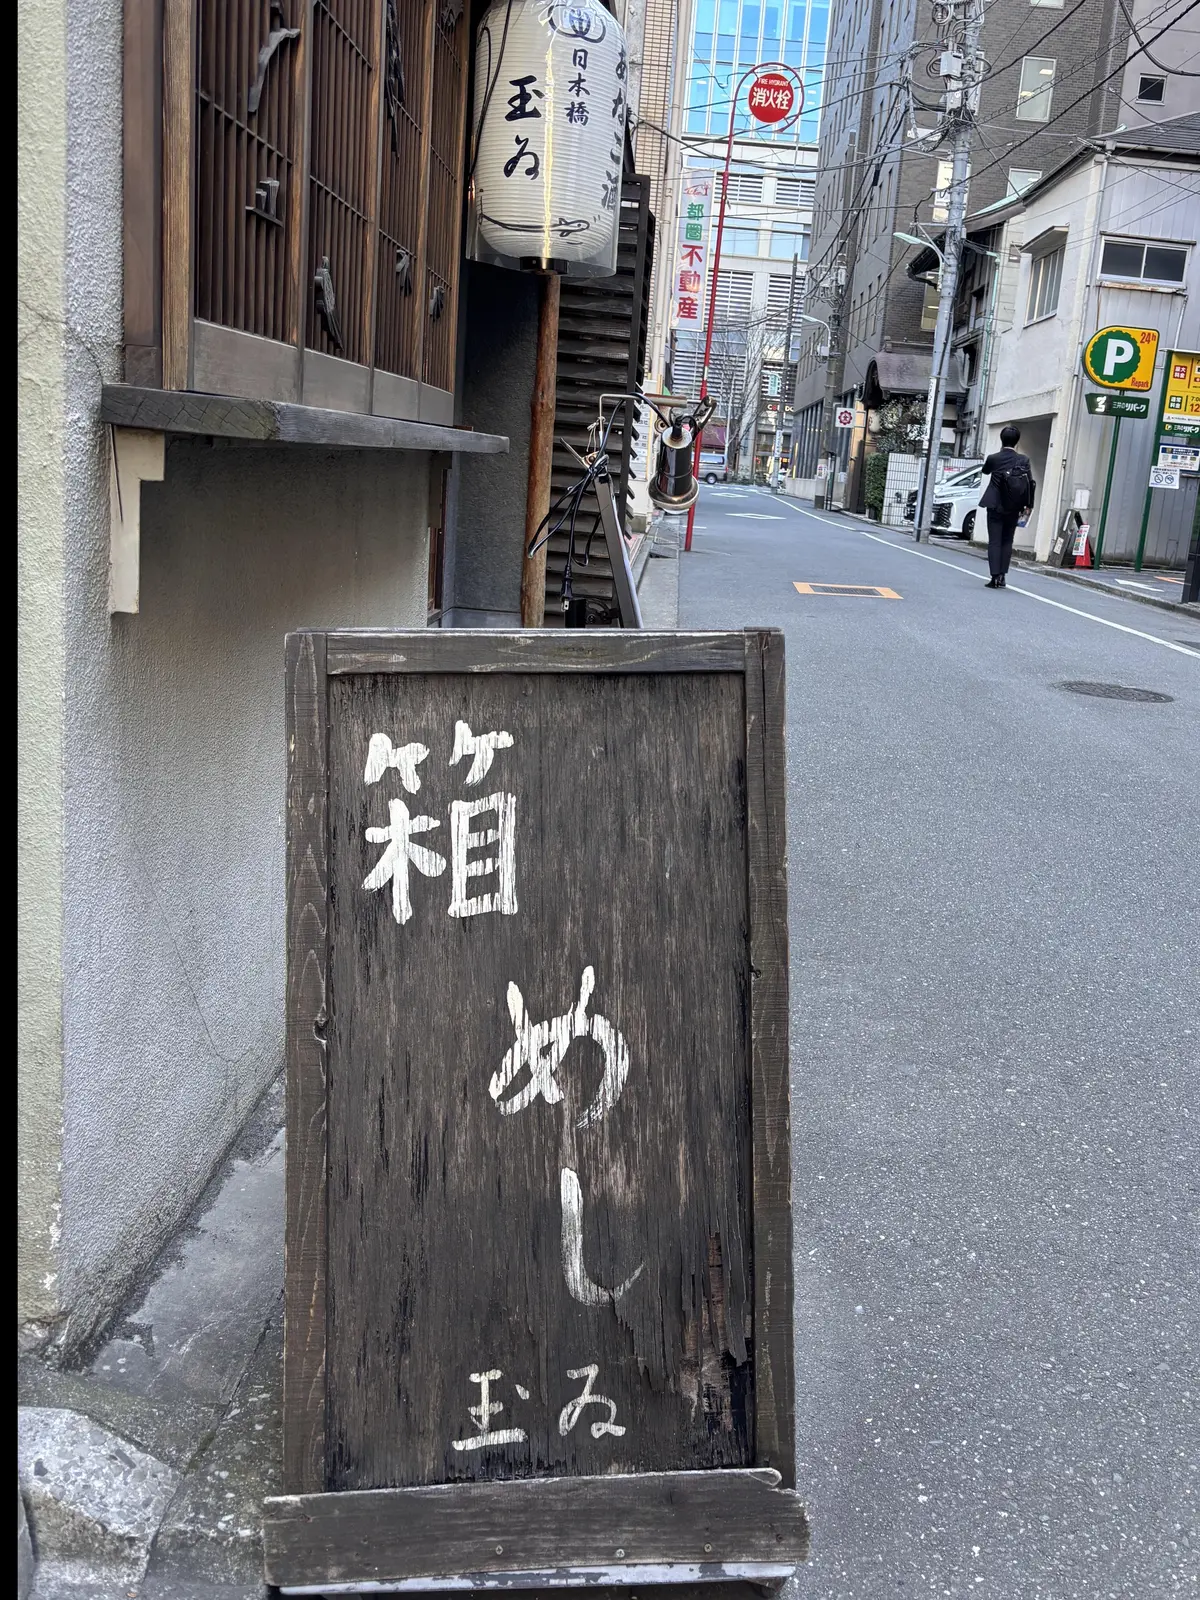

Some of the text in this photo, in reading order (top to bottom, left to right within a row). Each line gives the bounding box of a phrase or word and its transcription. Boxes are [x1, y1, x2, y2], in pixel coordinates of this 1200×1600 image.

[564, 49, 591, 126] 日本橋
[751, 87, 791, 110] 消火栓
[768, 79, 789, 87] HYDRANT
[676, 202, 704, 320] 都圏不動産
[1103, 338, 1134, 376] P
[1131, 377, 1149, 388] Repark
[362, 719, 645, 1307] 箱めし
